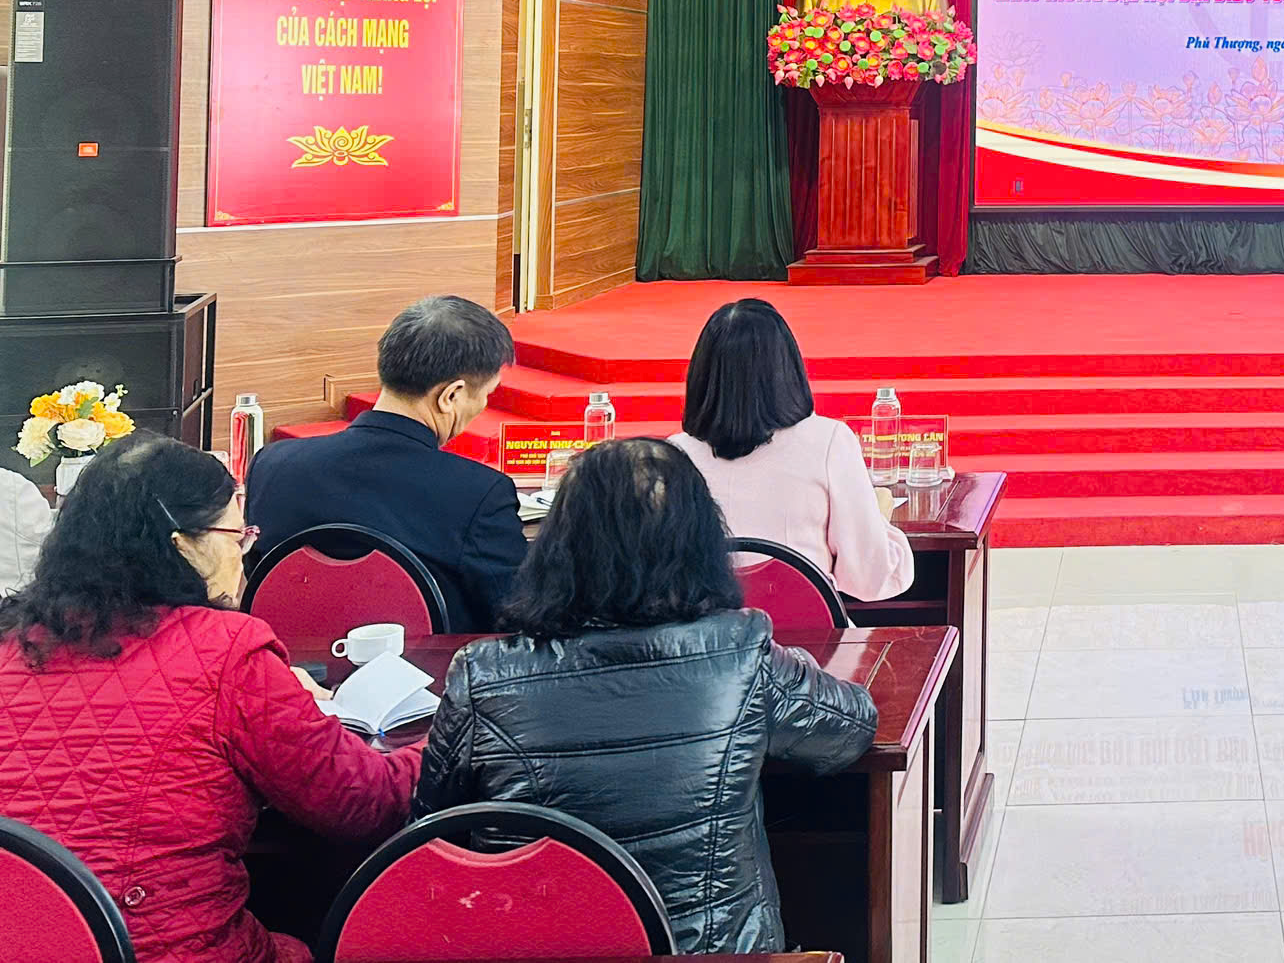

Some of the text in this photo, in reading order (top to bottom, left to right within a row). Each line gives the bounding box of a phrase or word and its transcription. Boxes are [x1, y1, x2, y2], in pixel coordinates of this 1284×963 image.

[276, 7, 409, 55] CỦA CÁCH MẠNG
[1186, 36, 1210, 49] Phú
[1214, 36, 1263, 53] Thượng,
[301, 59, 383, 101] VIỆT NAM!
